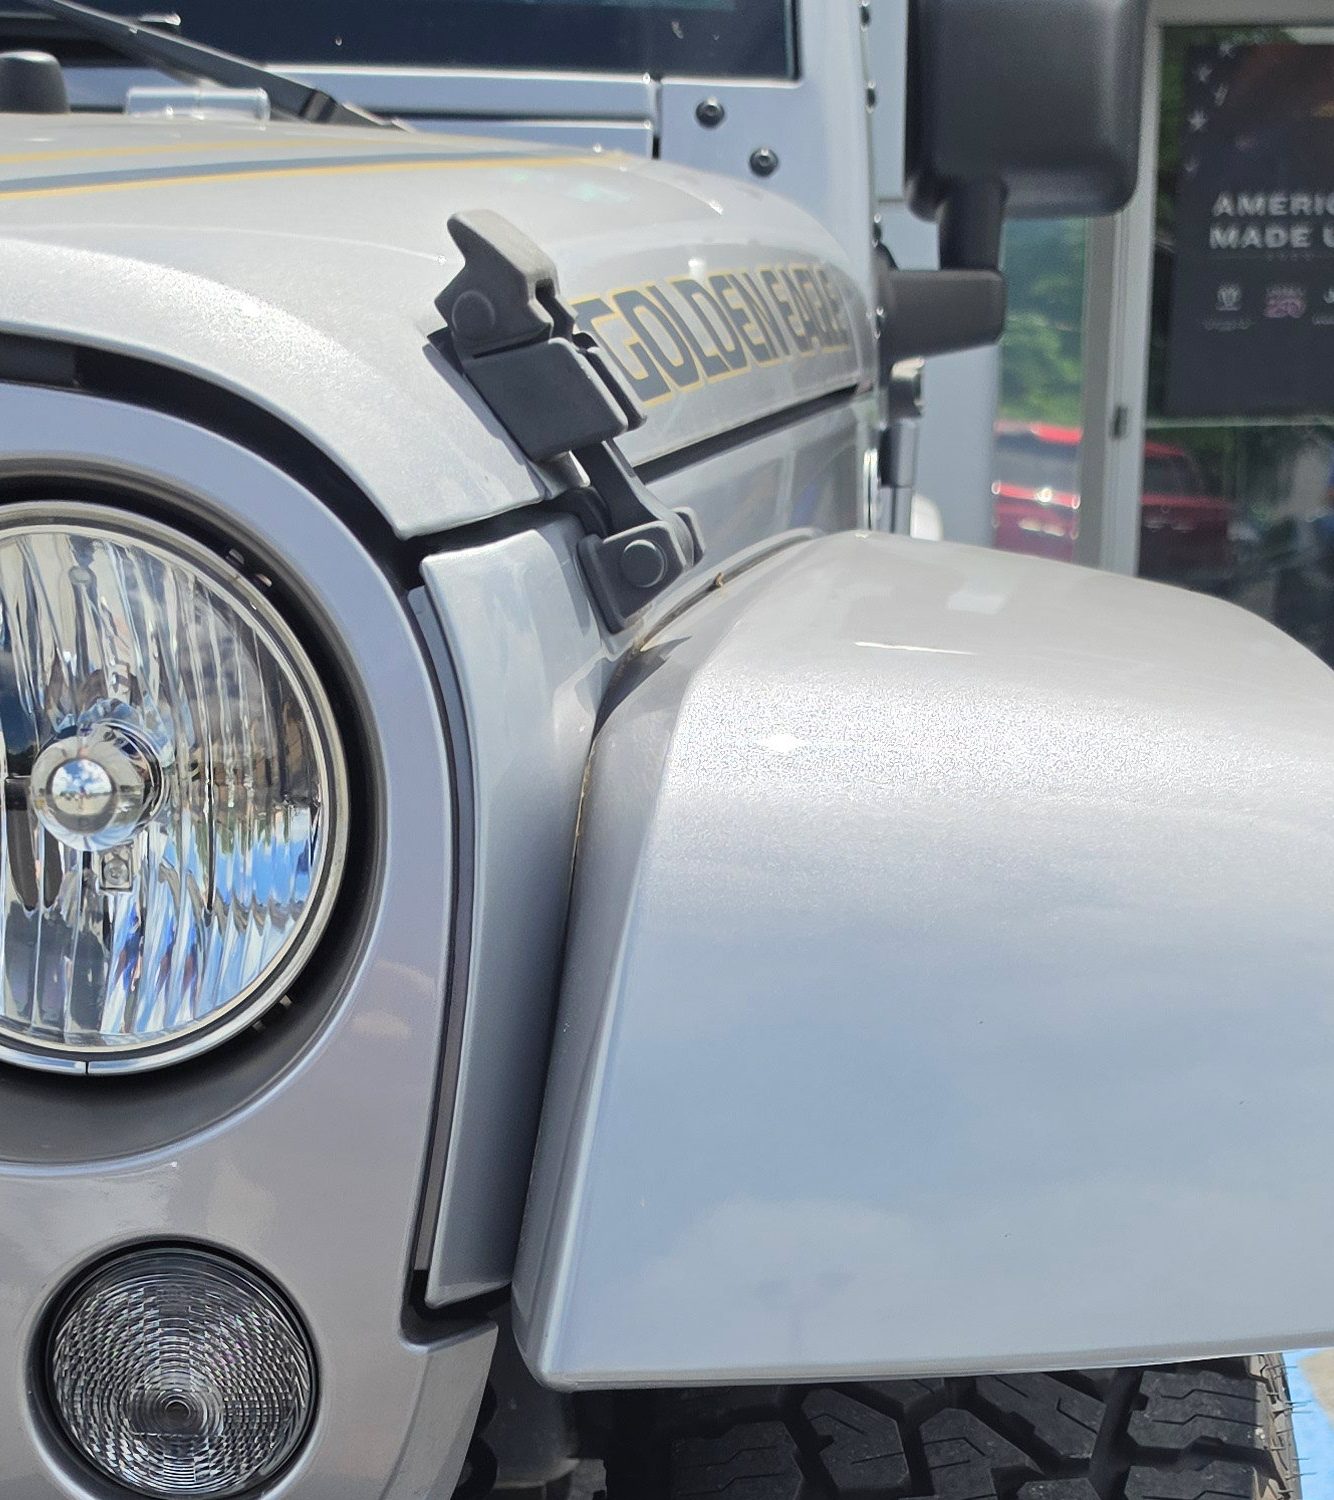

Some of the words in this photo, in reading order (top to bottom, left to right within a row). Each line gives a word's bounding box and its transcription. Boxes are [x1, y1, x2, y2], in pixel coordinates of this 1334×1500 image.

[1209, 222, 1313, 249] MADE
[570, 270, 791, 407] GOLDEN
[755, 264, 853, 356] EAGLE
